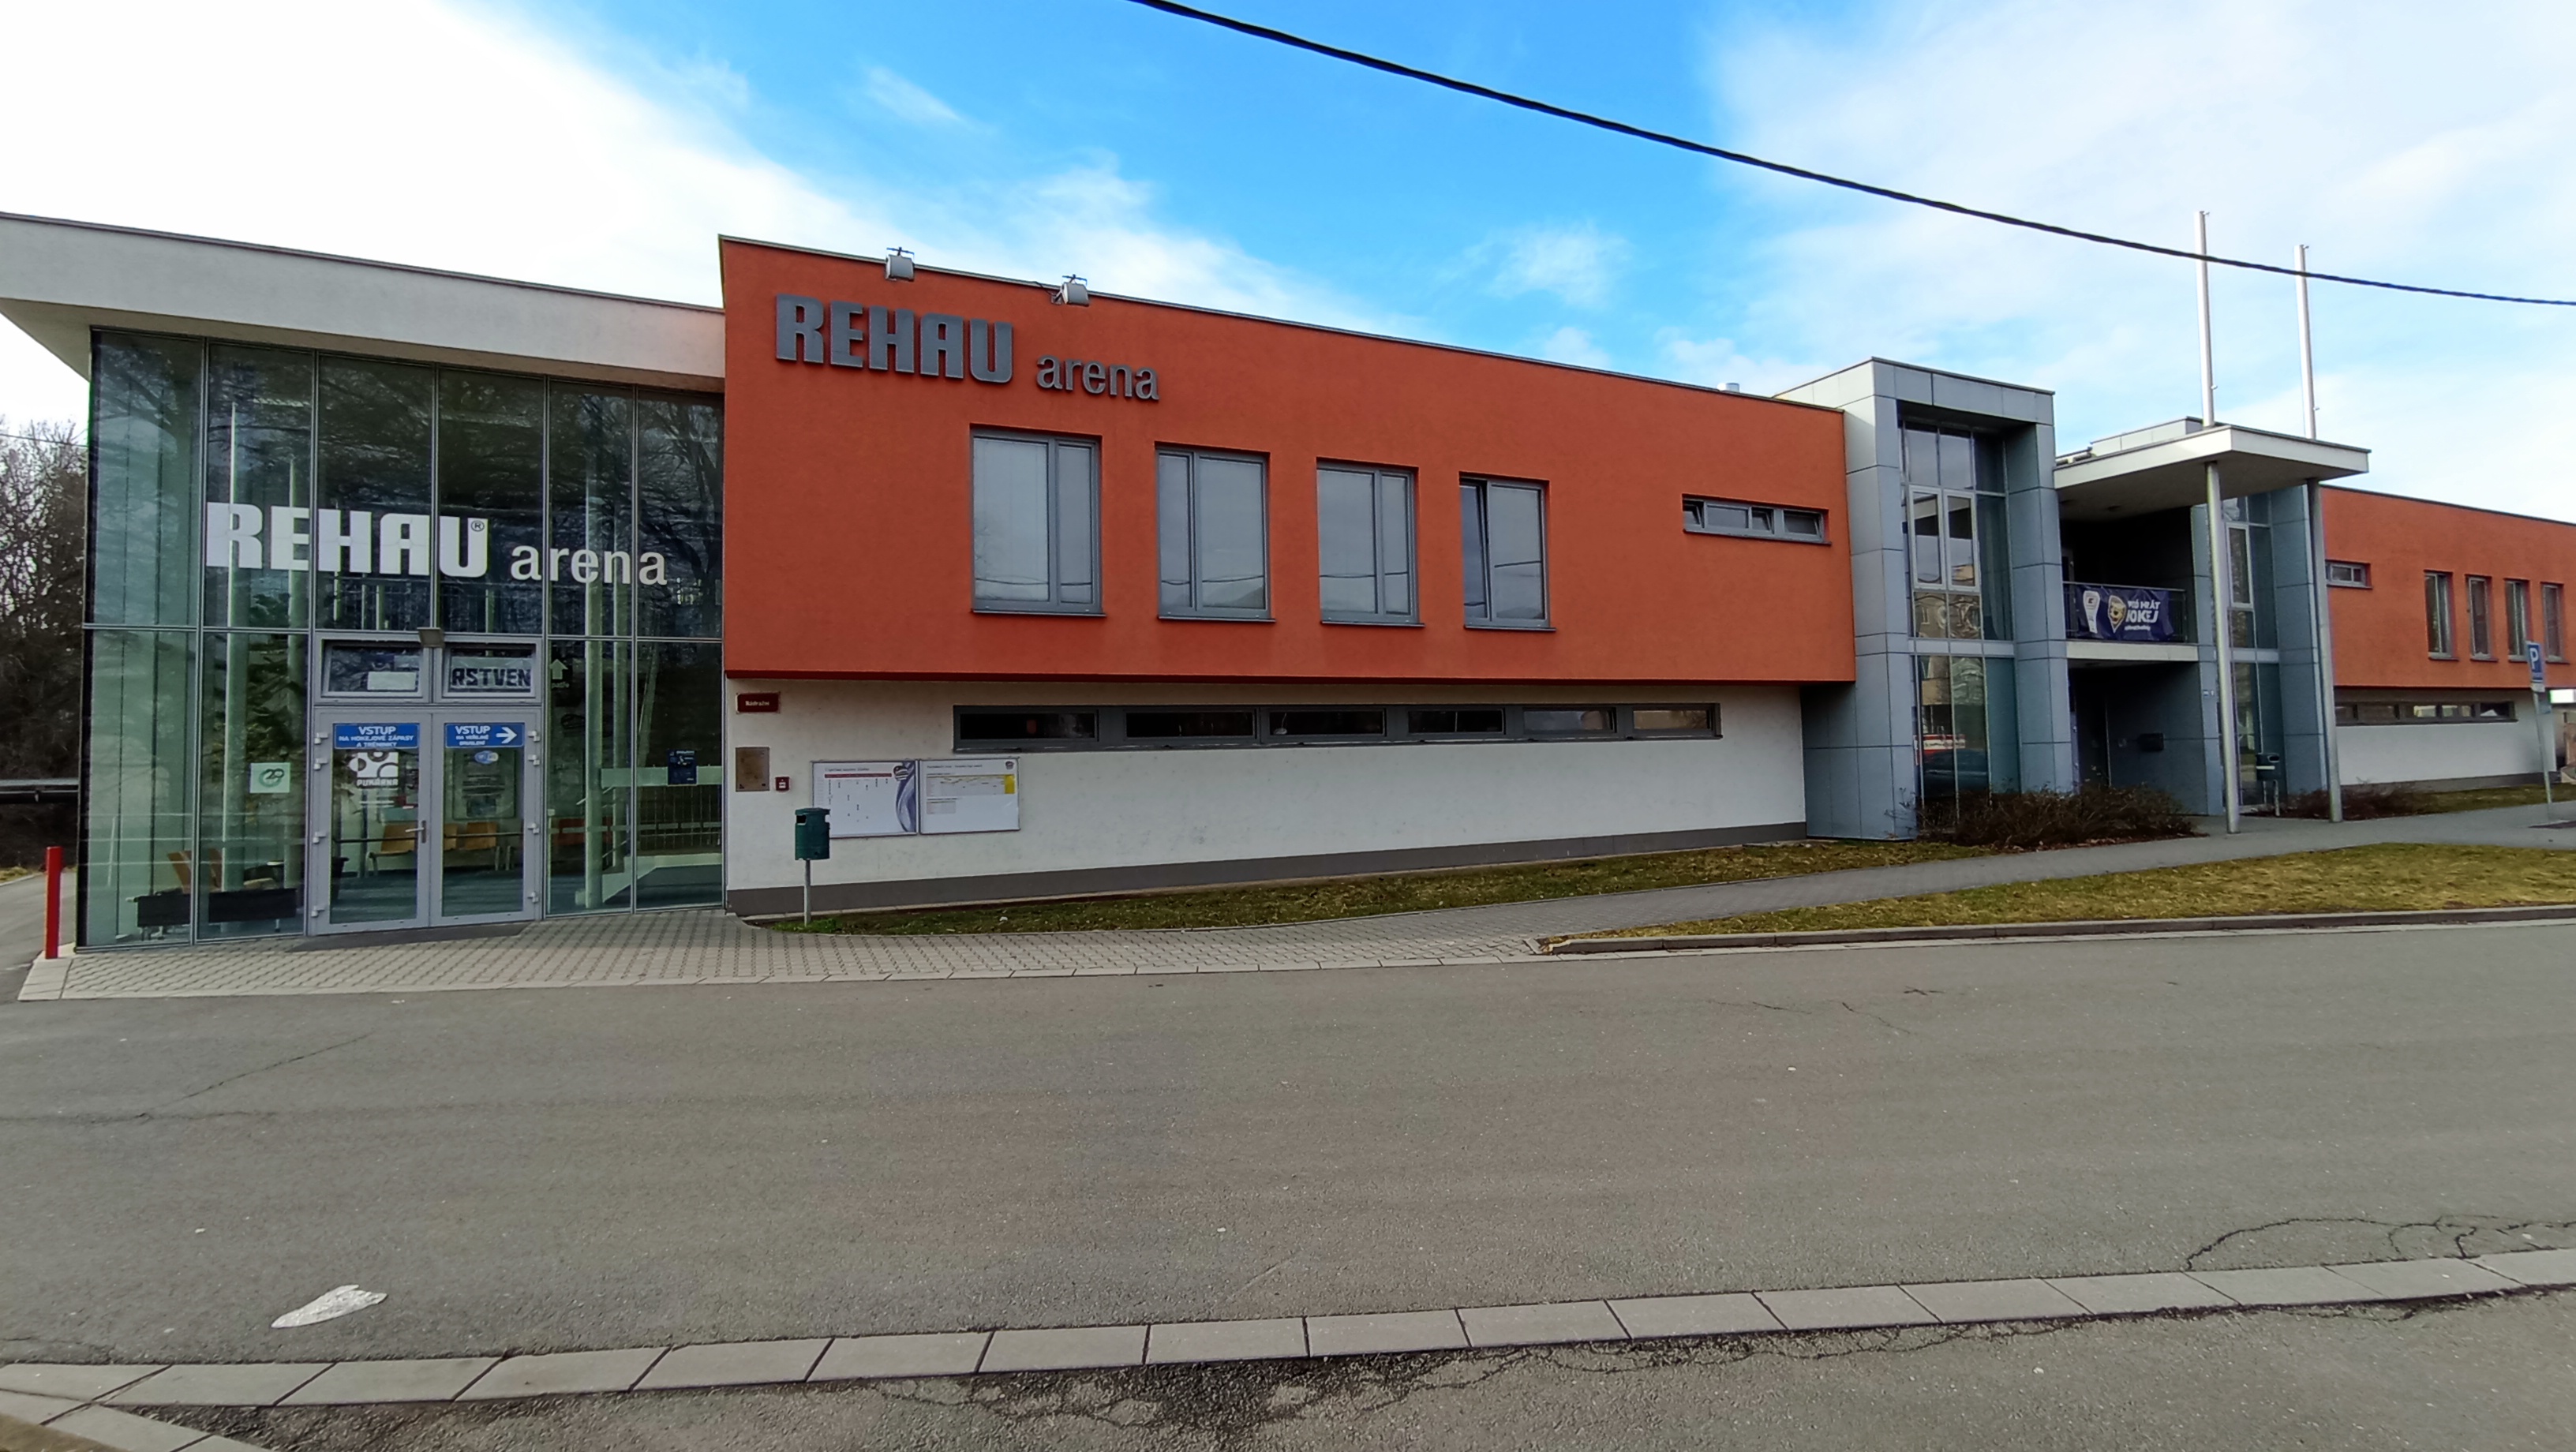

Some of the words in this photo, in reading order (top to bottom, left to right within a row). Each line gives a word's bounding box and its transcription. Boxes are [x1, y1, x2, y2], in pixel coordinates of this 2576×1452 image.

[774, 293, 1013, 384] REHAU
[1036, 354, 1159, 401] arena
[510, 544, 668, 586] arena
[2529, 647, 2539, 670] P
[358, 726, 396, 735] VSTUP
[455, 725, 491, 735] VSTUP
